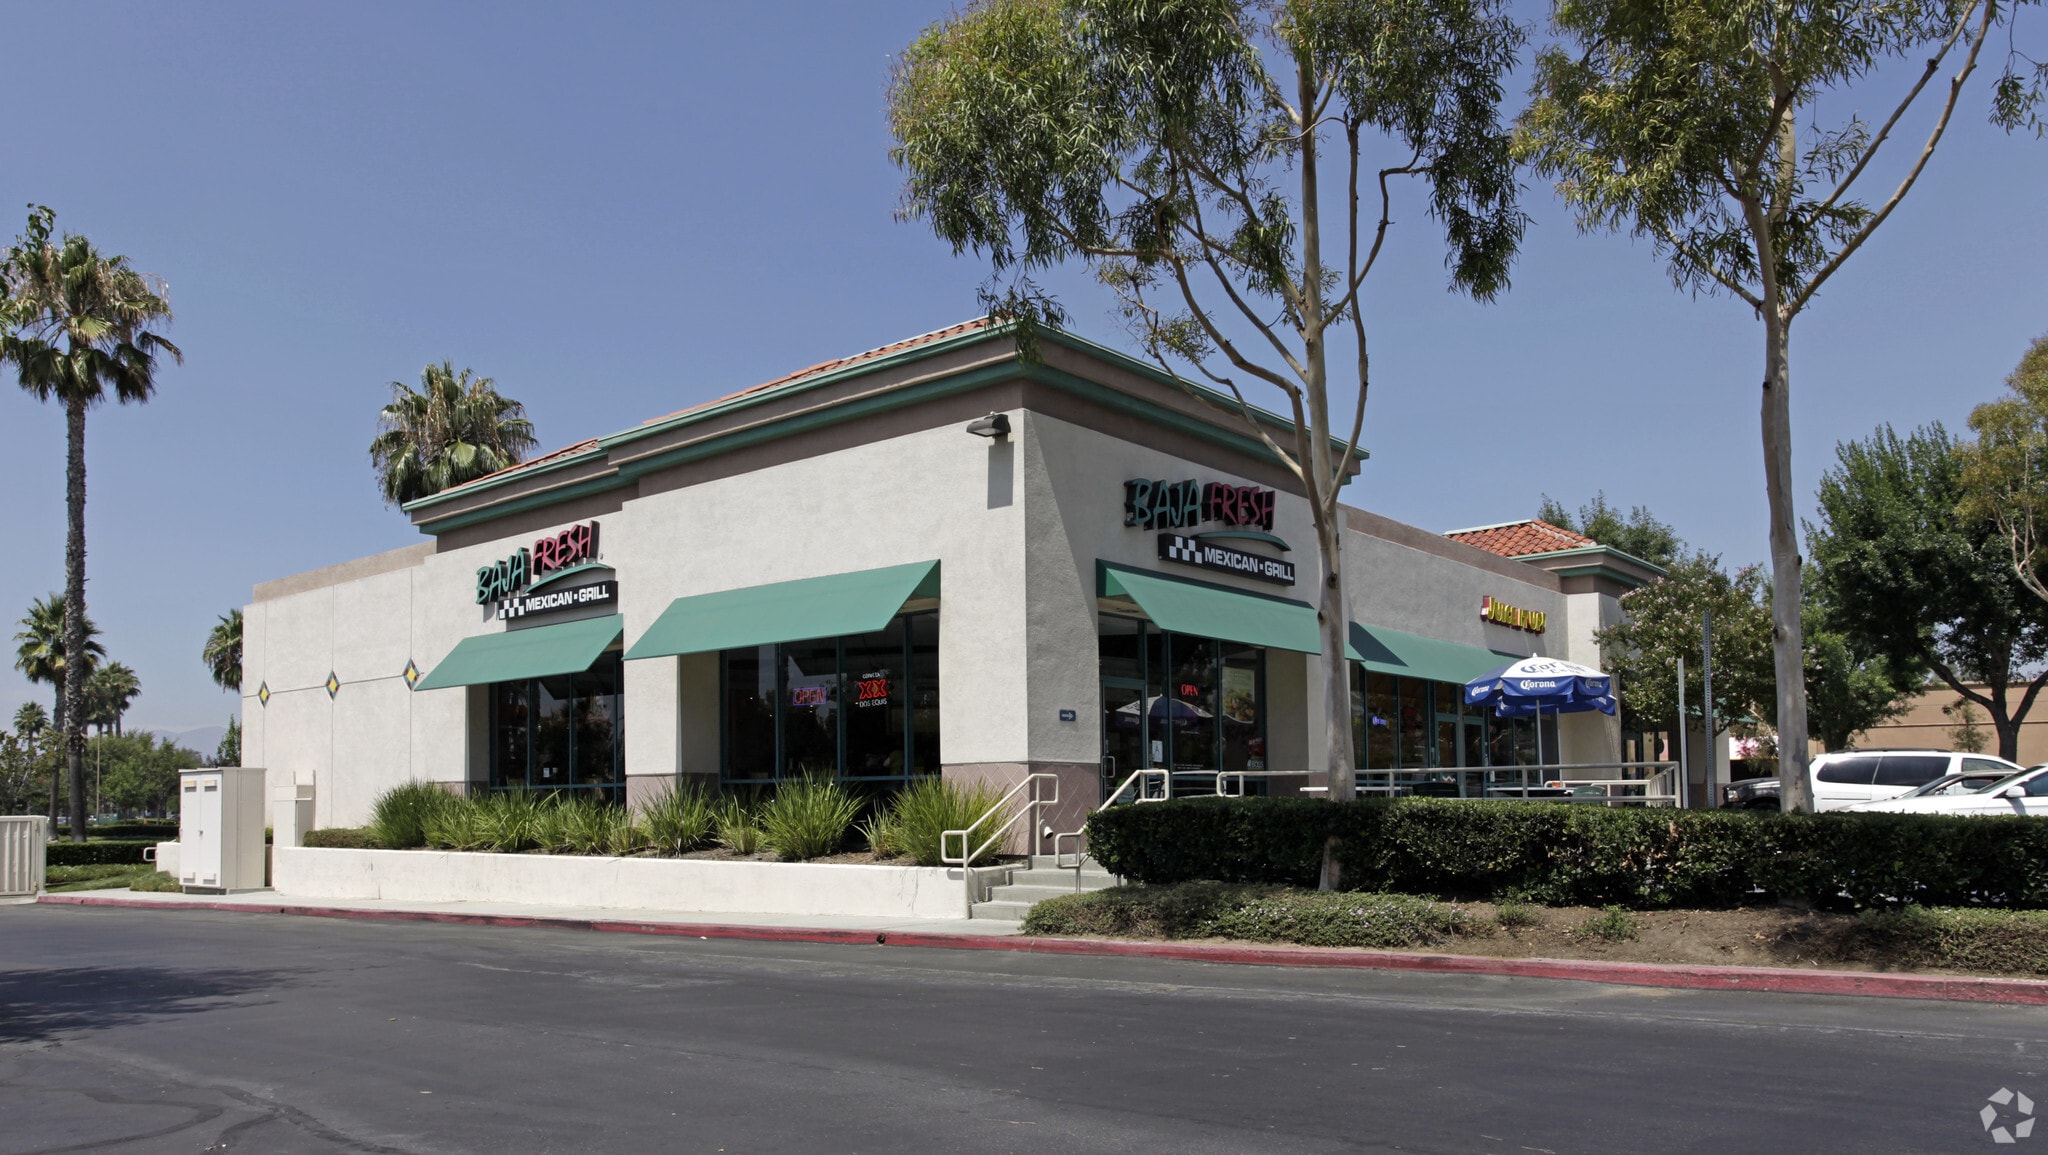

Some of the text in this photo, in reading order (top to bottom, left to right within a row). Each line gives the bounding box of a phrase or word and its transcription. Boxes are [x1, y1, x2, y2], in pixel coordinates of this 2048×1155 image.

[1127, 478, 1276, 530] BAJA FRESH
[476, 521, 597, 605] BAJA FRESH
[1204, 546, 1295, 581] MEXICAN GRILL
[525, 584, 610, 612] MEXICAN GRILL
[859, 680, 887, 699] XX
[1181, 684, 1199, 696] OPEN
[1520, 679, 1556, 690] Corona
[795, 688, 825, 704] OPEN
[859, 700, 871, 708] DOS
